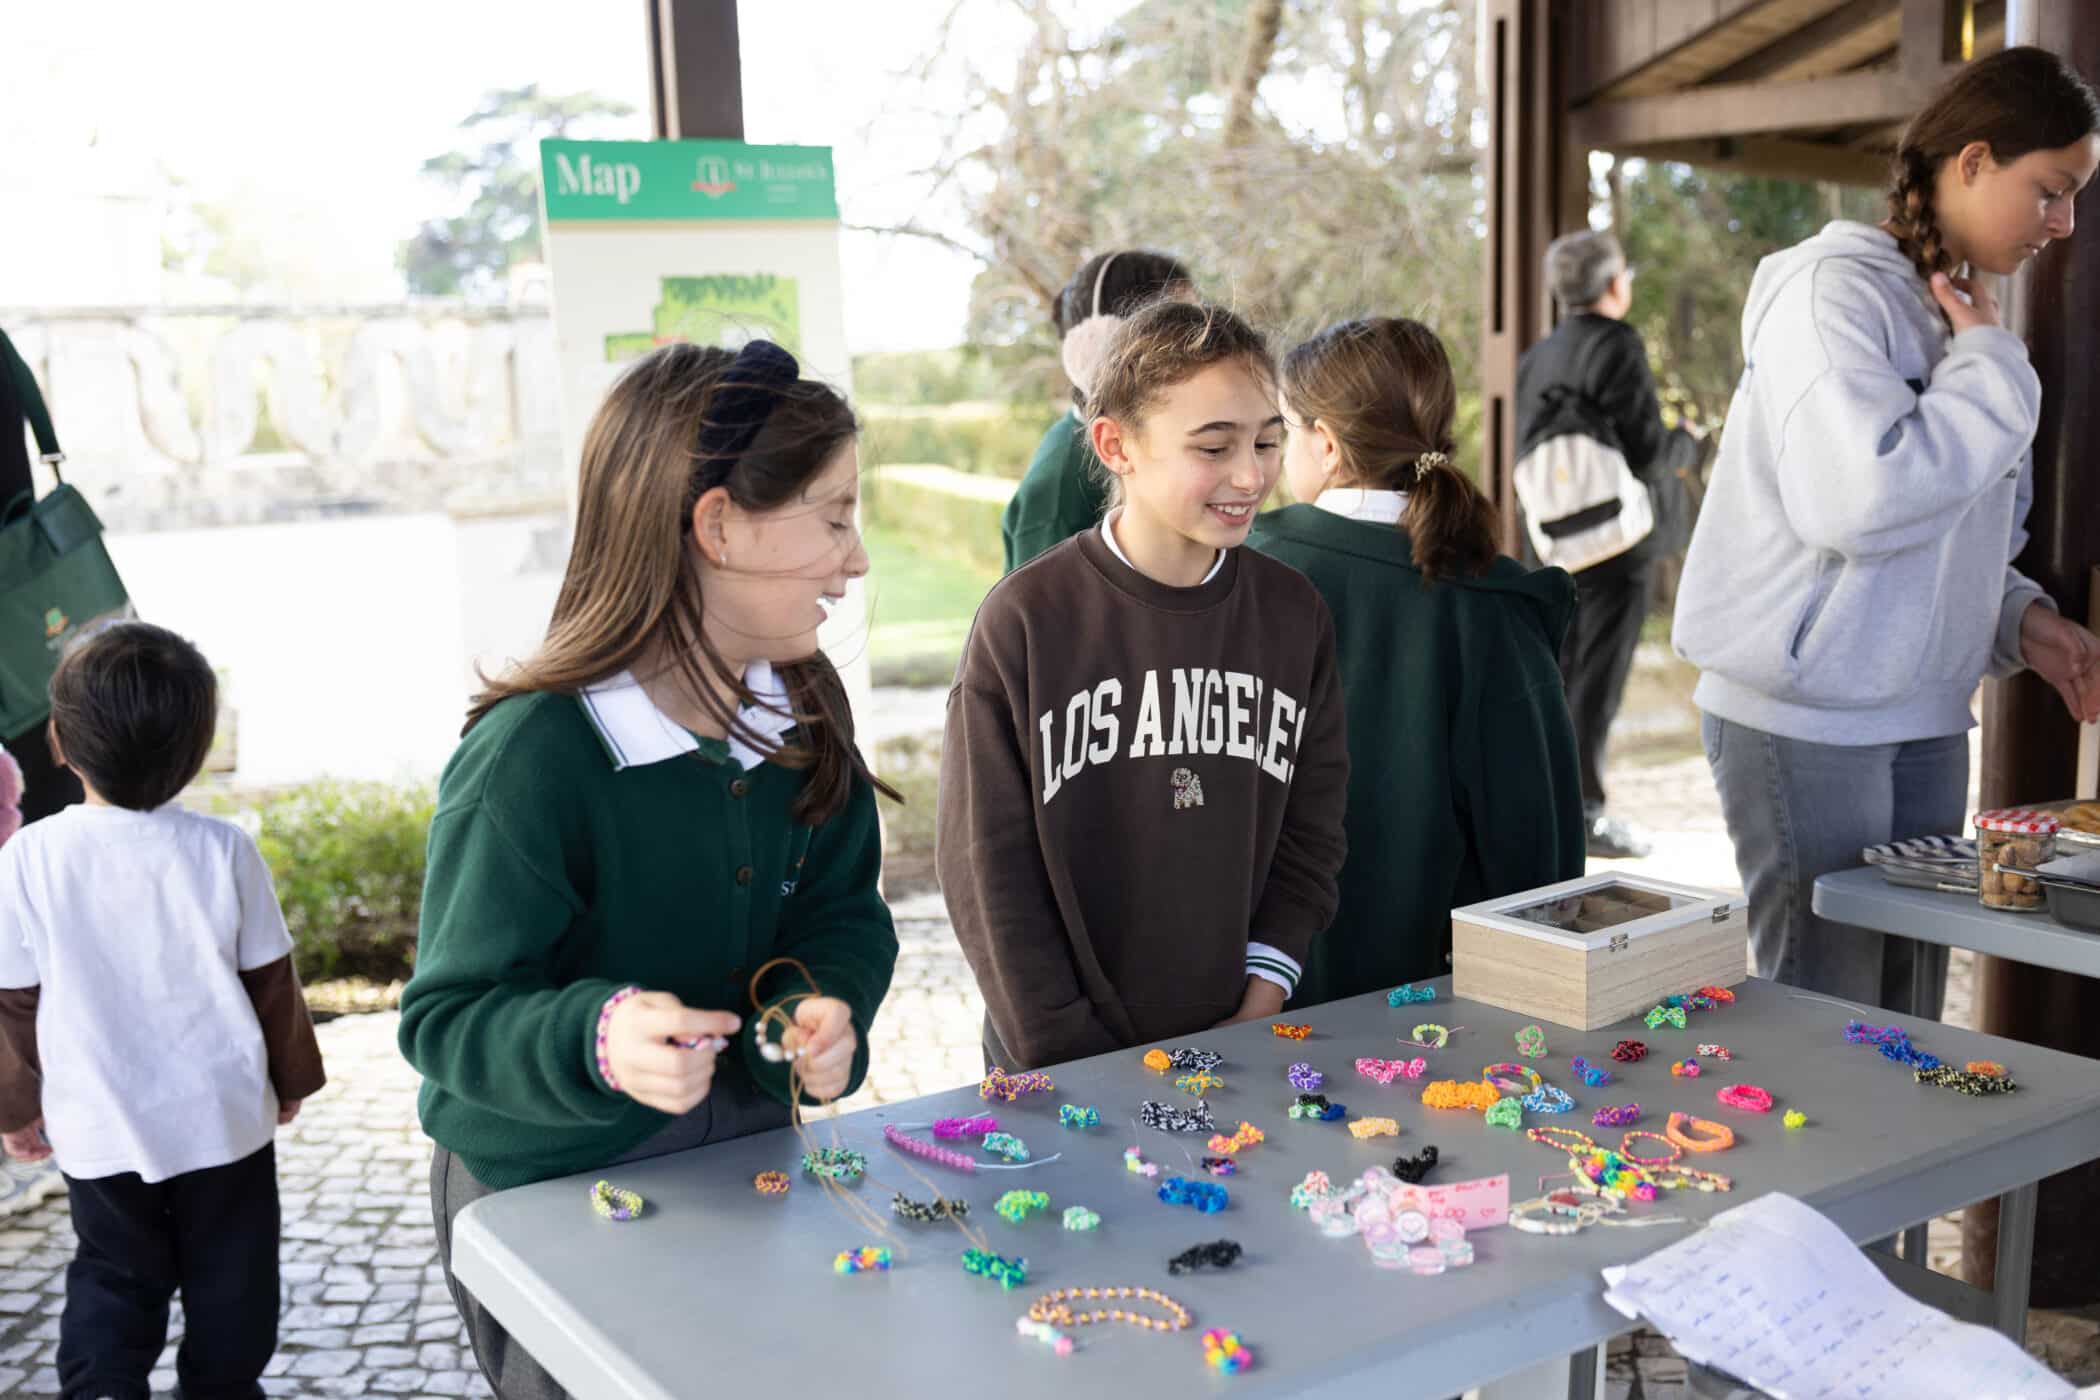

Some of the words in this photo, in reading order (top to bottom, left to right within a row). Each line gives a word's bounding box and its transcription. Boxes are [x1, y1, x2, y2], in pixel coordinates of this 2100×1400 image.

[556, 153, 640, 204] Map
[1039, 677, 1122, 805] LOS
[1129, 667, 1307, 785] ANGEE
